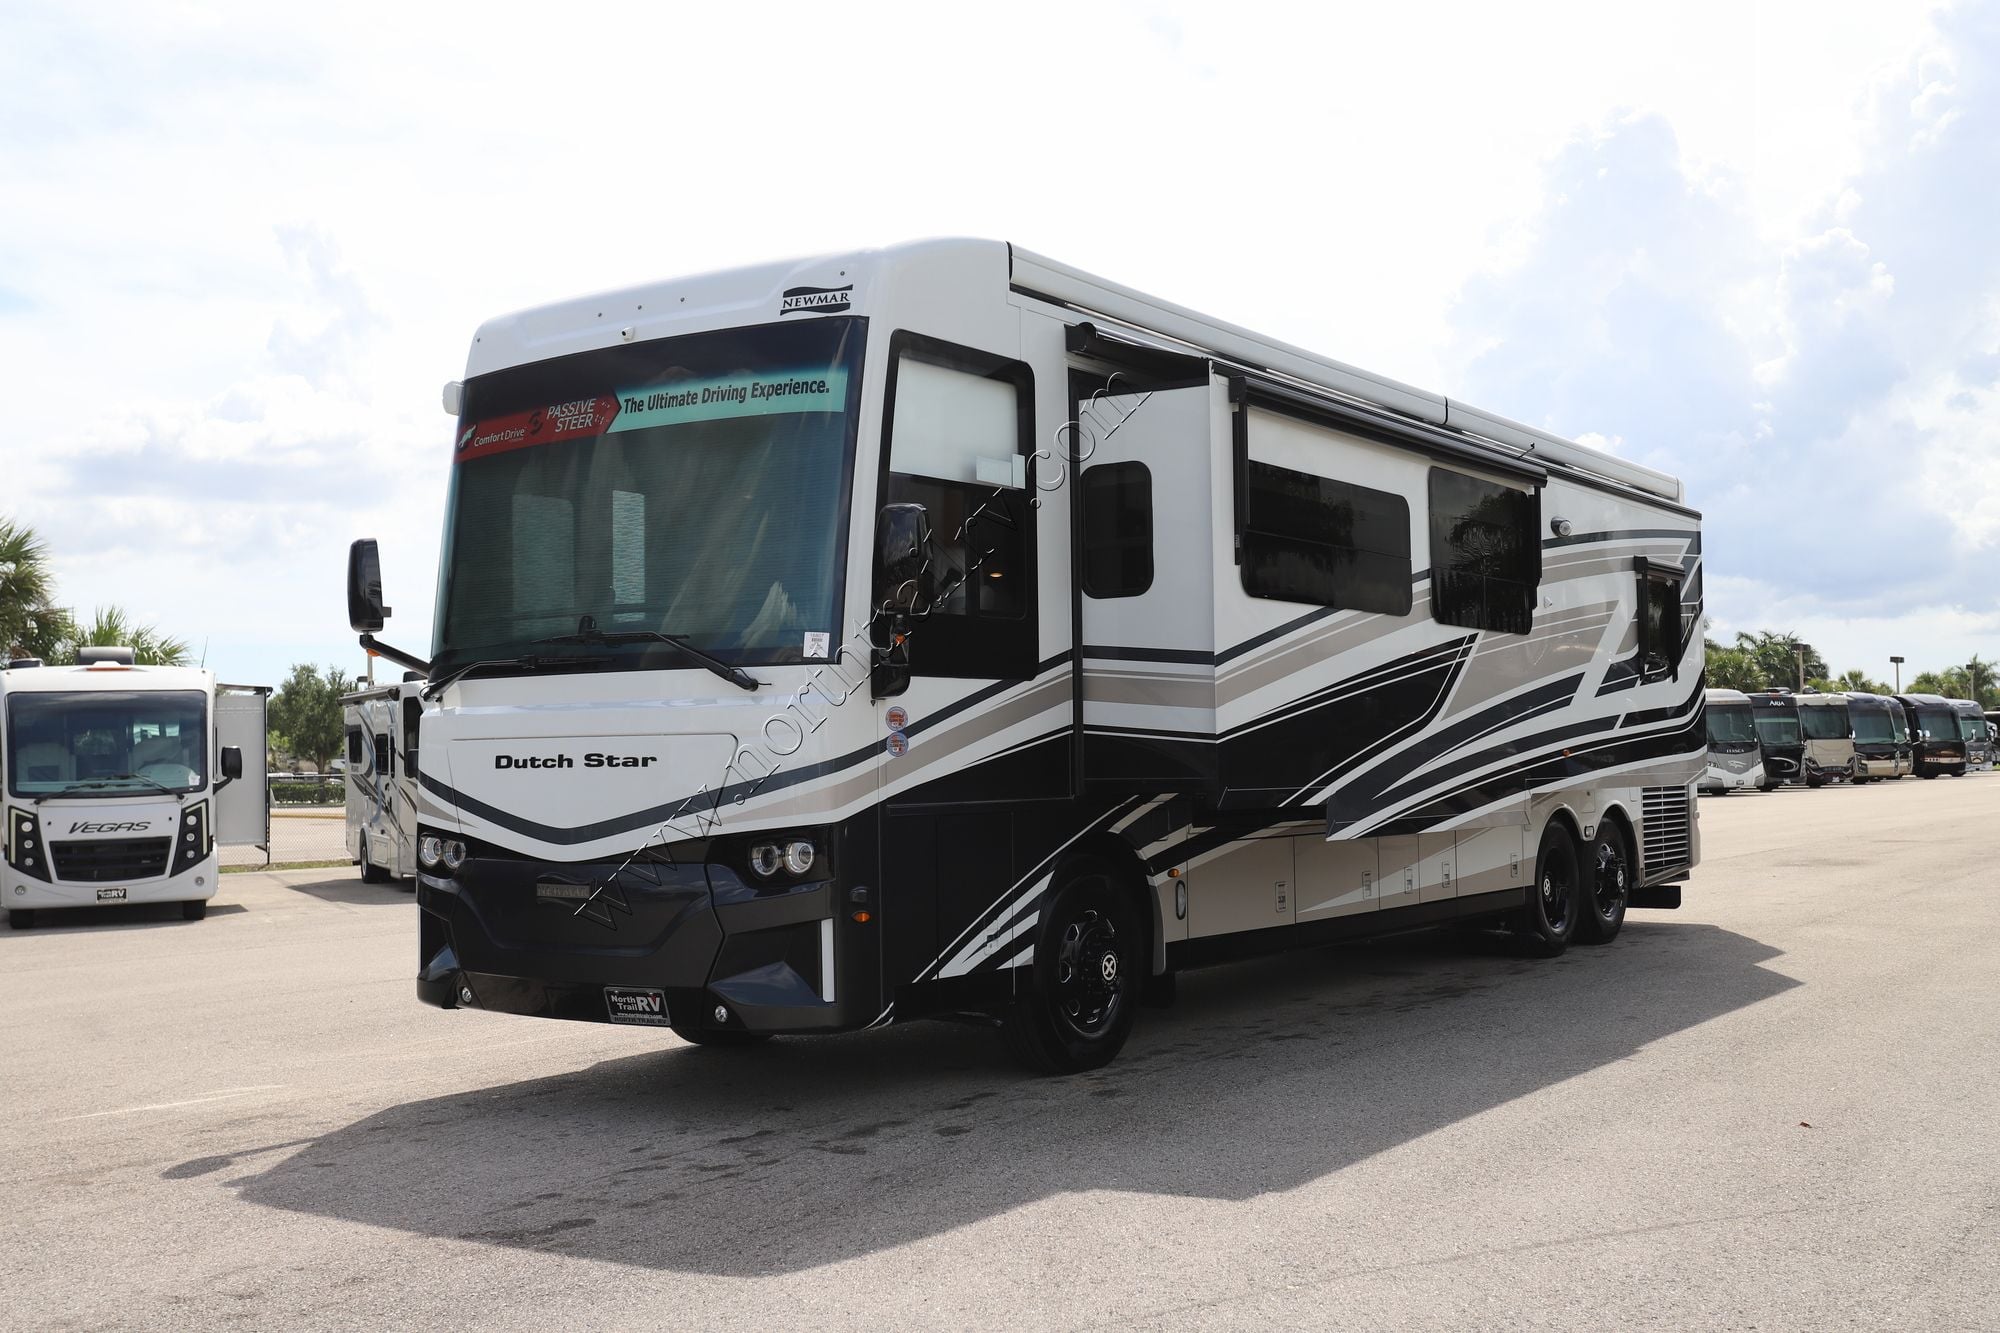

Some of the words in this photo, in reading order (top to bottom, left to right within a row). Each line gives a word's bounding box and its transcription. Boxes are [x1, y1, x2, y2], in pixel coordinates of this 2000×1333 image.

[783, 292, 850, 308] NEWMAR
[624, 398, 644, 414] The
[647, 390, 698, 411] Ultimate
[701, 385, 747, 404] Driving
[751, 378, 830, 400] Experience.
[546, 398, 597, 419] PASSIVE
[555, 413, 594, 432] STEER
[495, 754, 574, 769] Dutch
[584, 753, 658, 768] Star
[68, 821, 152, 834] VEGAS
[611, 995, 636, 1003] North
[617, 1002, 637, 1010] Trail
[636, 996, 660, 1011] RV
